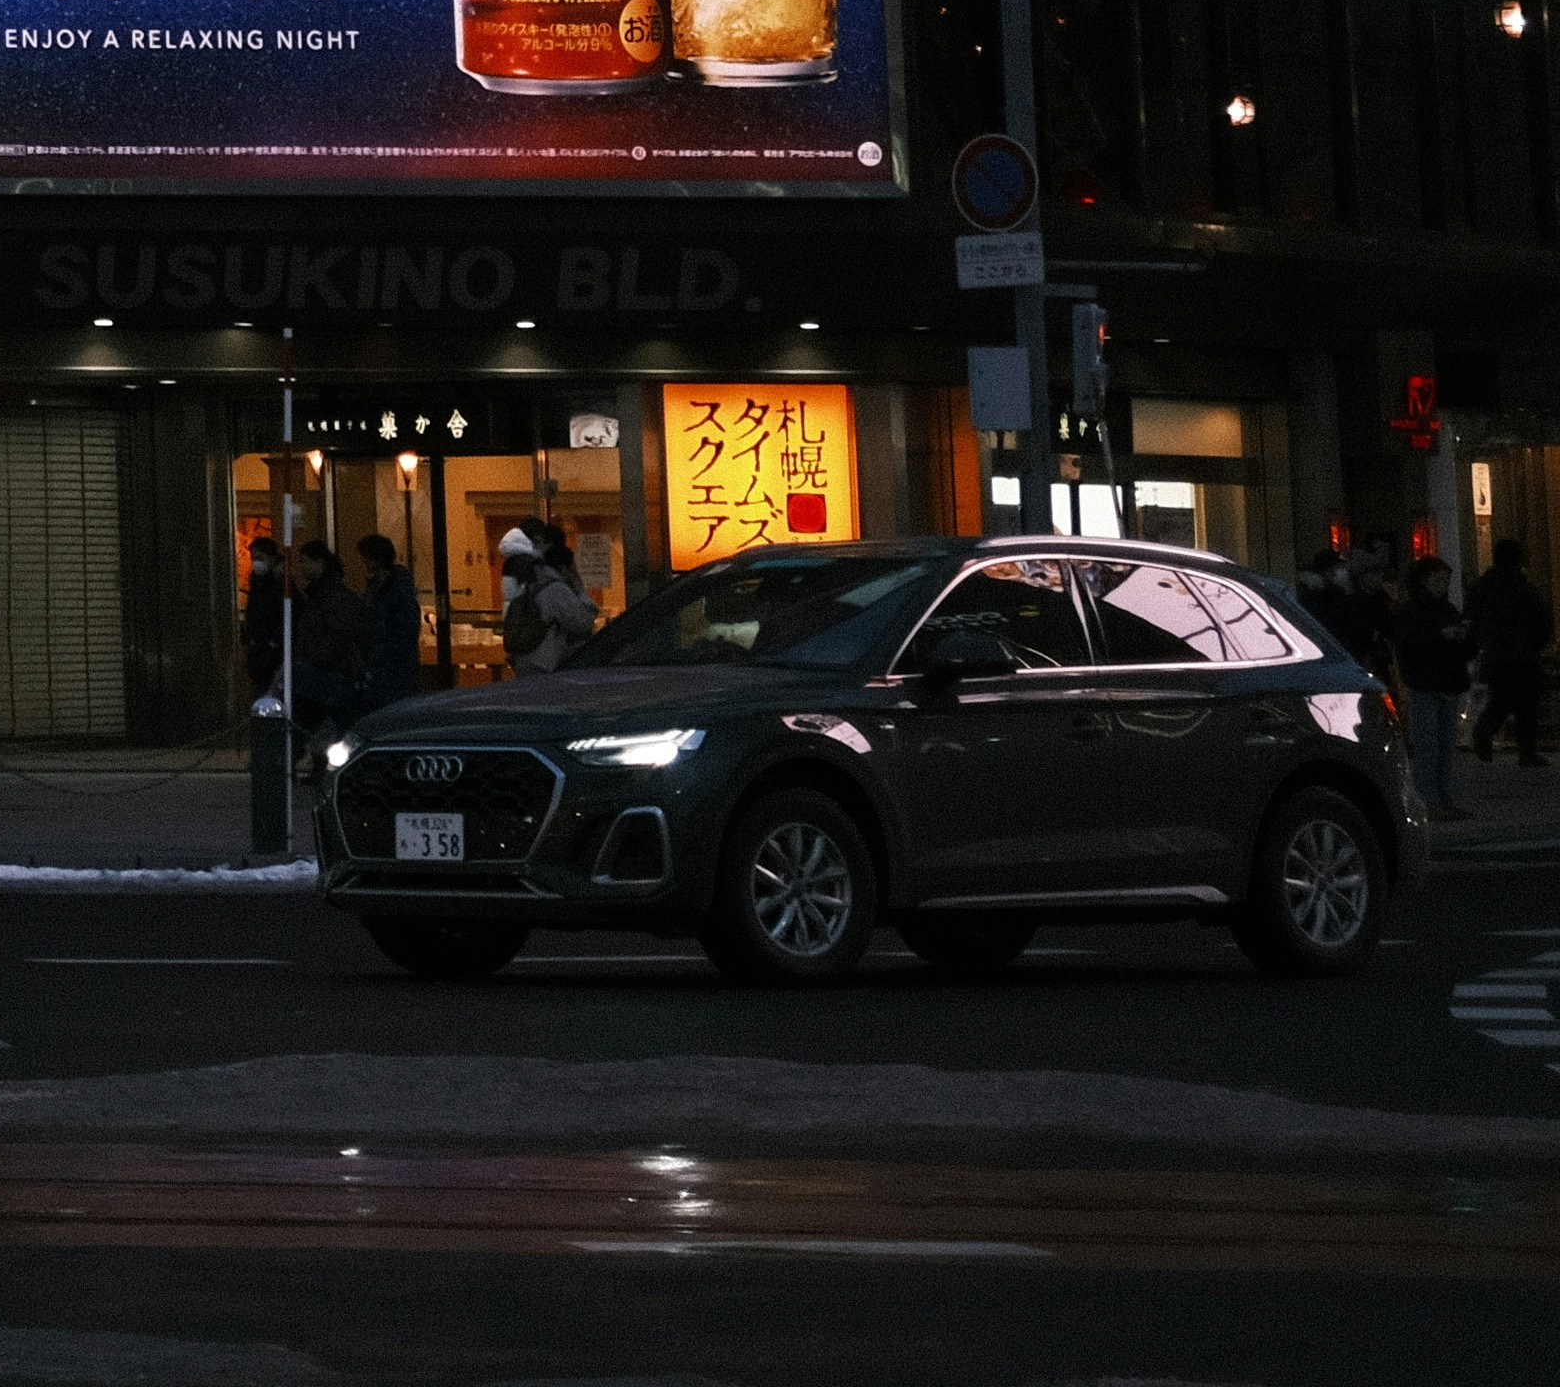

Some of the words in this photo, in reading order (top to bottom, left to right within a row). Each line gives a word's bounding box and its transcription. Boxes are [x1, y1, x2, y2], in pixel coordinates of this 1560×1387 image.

[4, 29, 93, 50] ENJOY
[102, 30, 119, 50] A
[131, 29, 265, 50] RELAXING
[277, 29, 360, 50] NIGHT
[39, 243, 517, 312] SUSUKINO
[556, 246, 763, 313] BLD.
[683, 400, 730, 553] スクエア
[732, 399, 784, 548] タイムズ
[776, 399, 828, 491] 札幌
